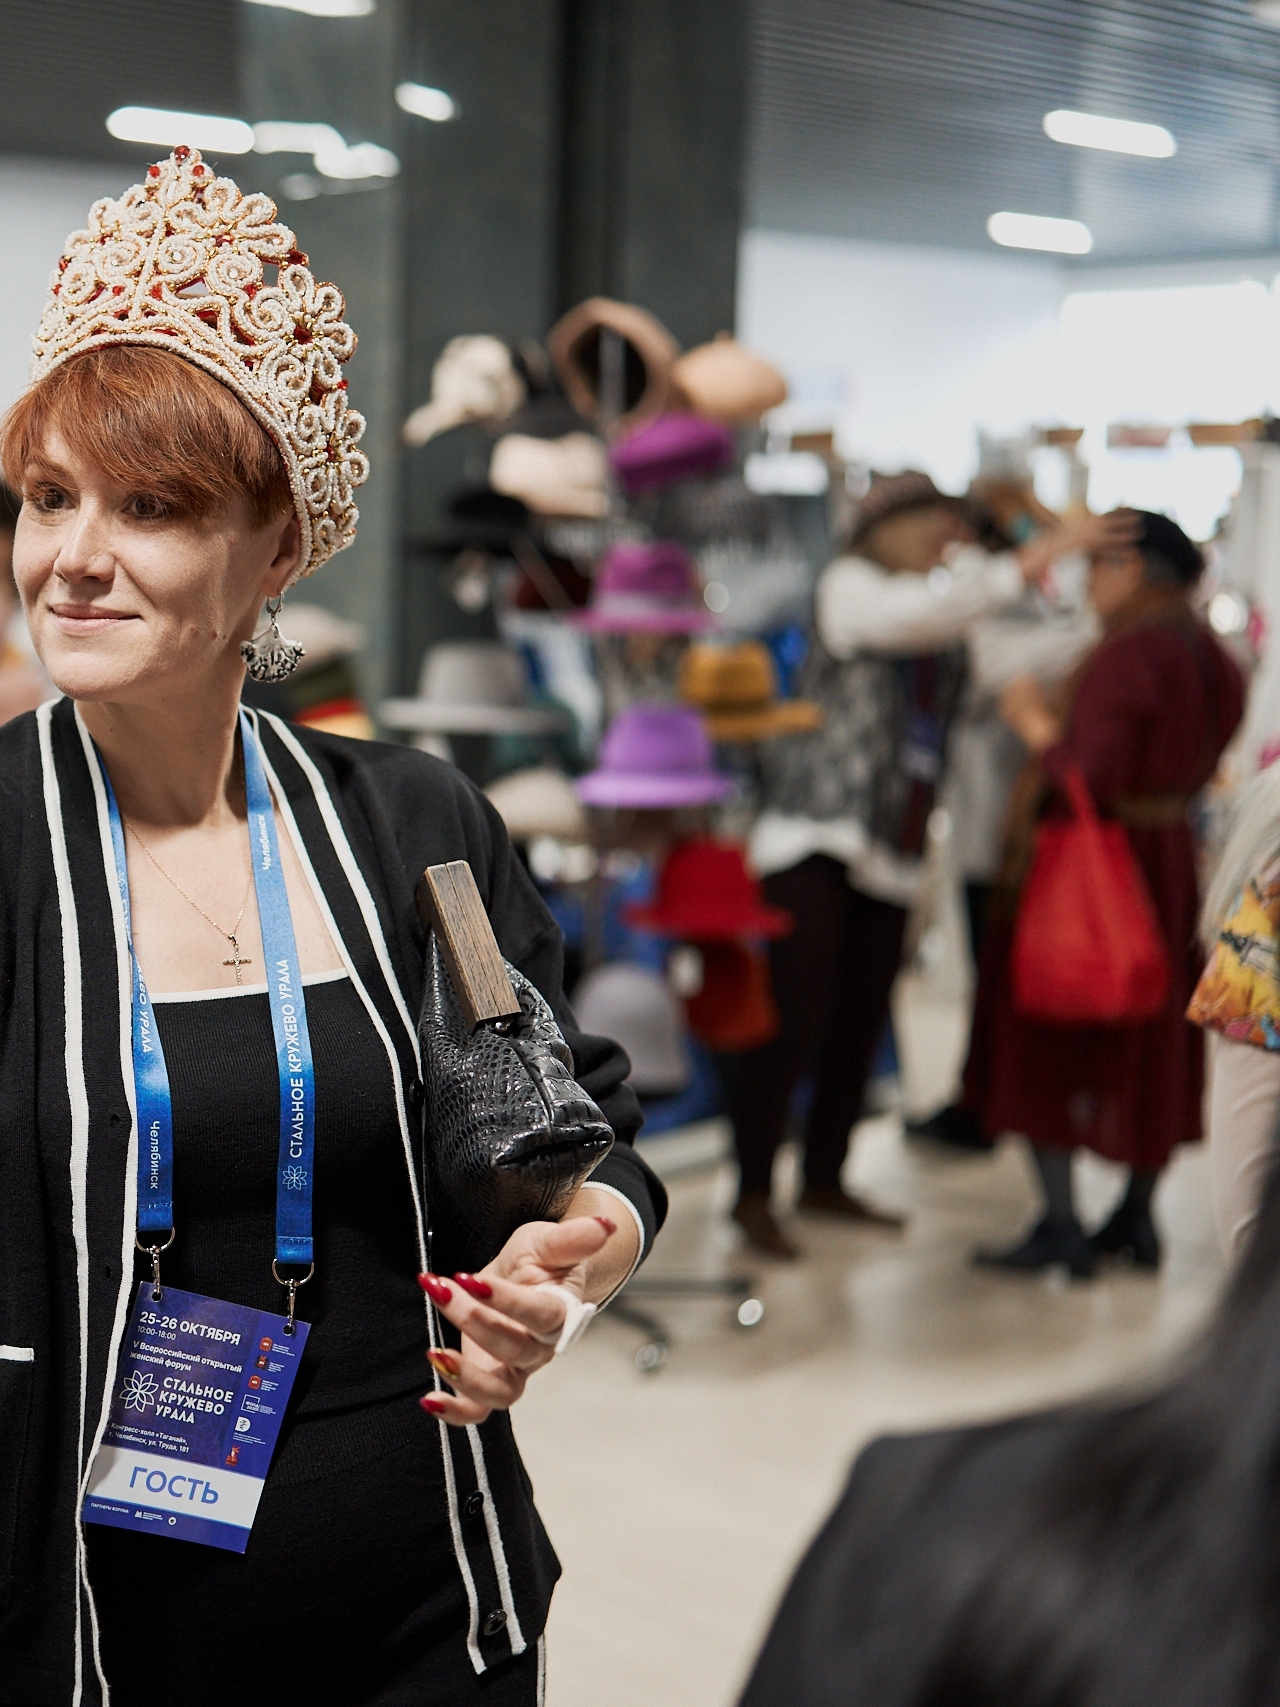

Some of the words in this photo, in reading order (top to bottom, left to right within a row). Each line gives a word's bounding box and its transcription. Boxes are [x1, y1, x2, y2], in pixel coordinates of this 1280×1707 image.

[257, 814, 271, 871] Челябинск
[276, 958, 293, 1000] УРАЛА
[140, 1010, 153, 1053] УРАЛА
[281, 1003, 302, 1073] КРУЖЕВО
[290, 1077, 304, 1158] СТАЛЬНОЕ
[150, 1120, 161, 1189] Челябинск
[137, 1325, 177, 1340] 10:00-18:00
[139, 1311, 178, 1330] 25-26
[180, 1320, 241, 1345] ОКТЯБРЯ
[129, 1352, 165, 1365] женский
[164, 1357, 192, 1371] форум
[133, 1340, 140, 1348] V
[139, 1342, 201, 1363] Всероссийский
[201, 1358, 243, 1373] открытый
[158, 1390, 225, 1415] КРУЖЕВО
[163, 1377, 234, 1403] СТАЛЬНОЕ
[111, 1422, 155, 1438] Конгресс-холл
[155, 1404, 195, 1424] УРАЛА
[115, 1432, 147, 1445] Челябинск,
[148, 1438, 157, 1447] ул.
[158, 1440, 178, 1451] Труда,
[179, 1445, 190, 1453] 181
[129, 1466, 219, 1504] ГОСТЬ
